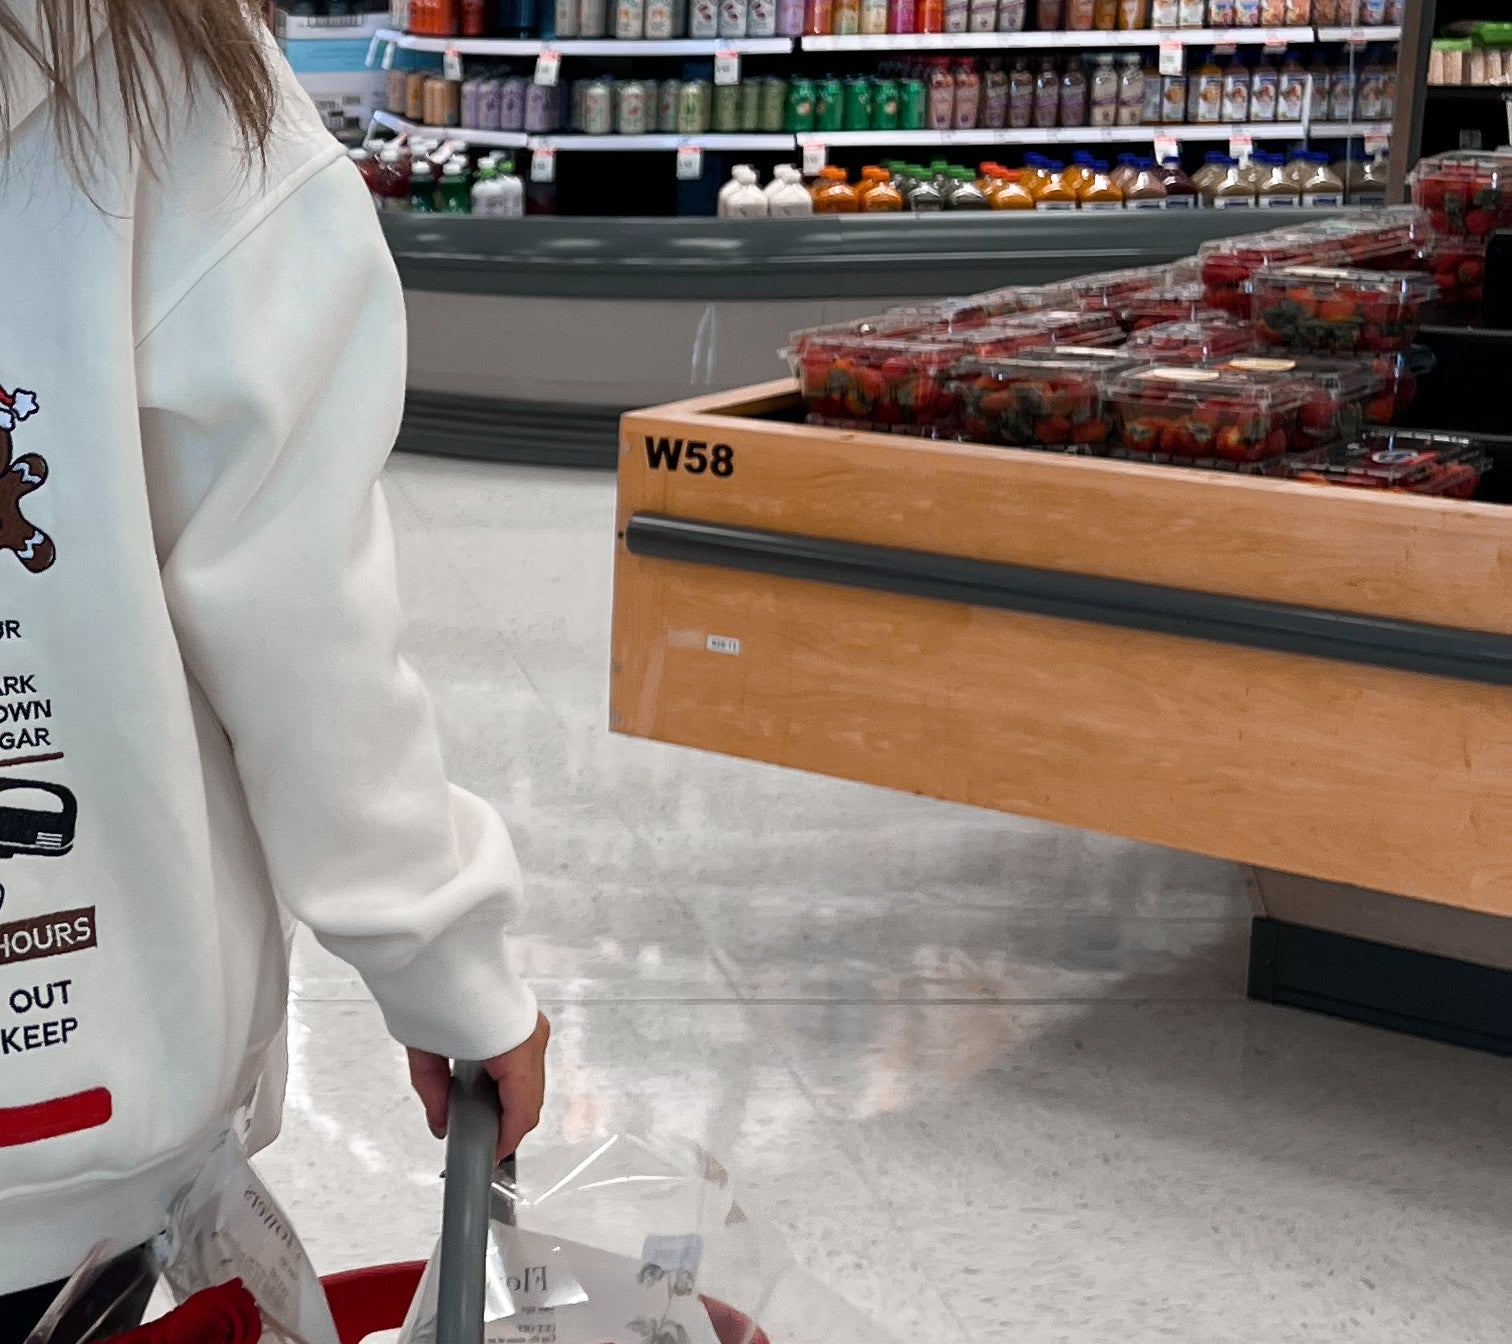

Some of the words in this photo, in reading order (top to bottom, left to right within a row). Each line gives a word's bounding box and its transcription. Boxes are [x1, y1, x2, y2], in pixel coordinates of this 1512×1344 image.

[645, 435, 735, 478] W58
[9, 979, 72, 1013] OUT
[1, 1017, 78, 1055] KEEP
